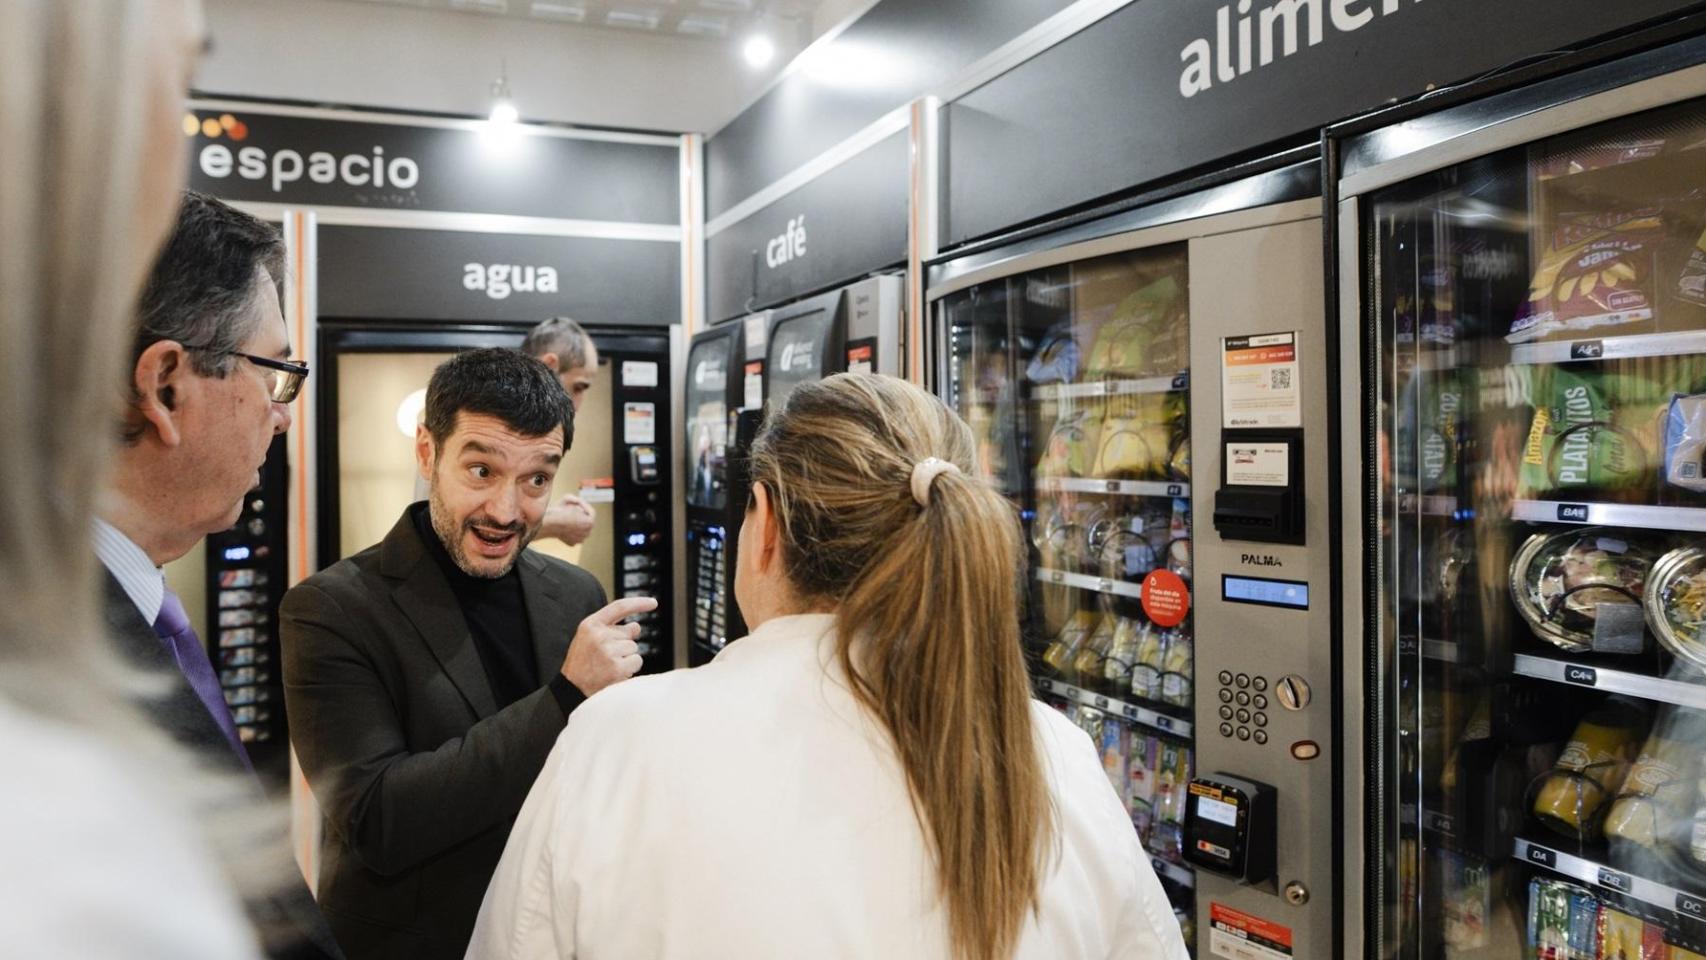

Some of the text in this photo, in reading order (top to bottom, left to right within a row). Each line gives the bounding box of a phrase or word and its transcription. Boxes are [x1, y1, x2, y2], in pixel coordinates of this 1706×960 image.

[199, 144, 419, 192] espacio
[766, 214, 807, 269] café
[463, 262, 558, 299] agua
[1241, 554, 1282, 567] PALMA
[1532, 850, 1547, 861] DA
[1683, 901, 1701, 913] DC
